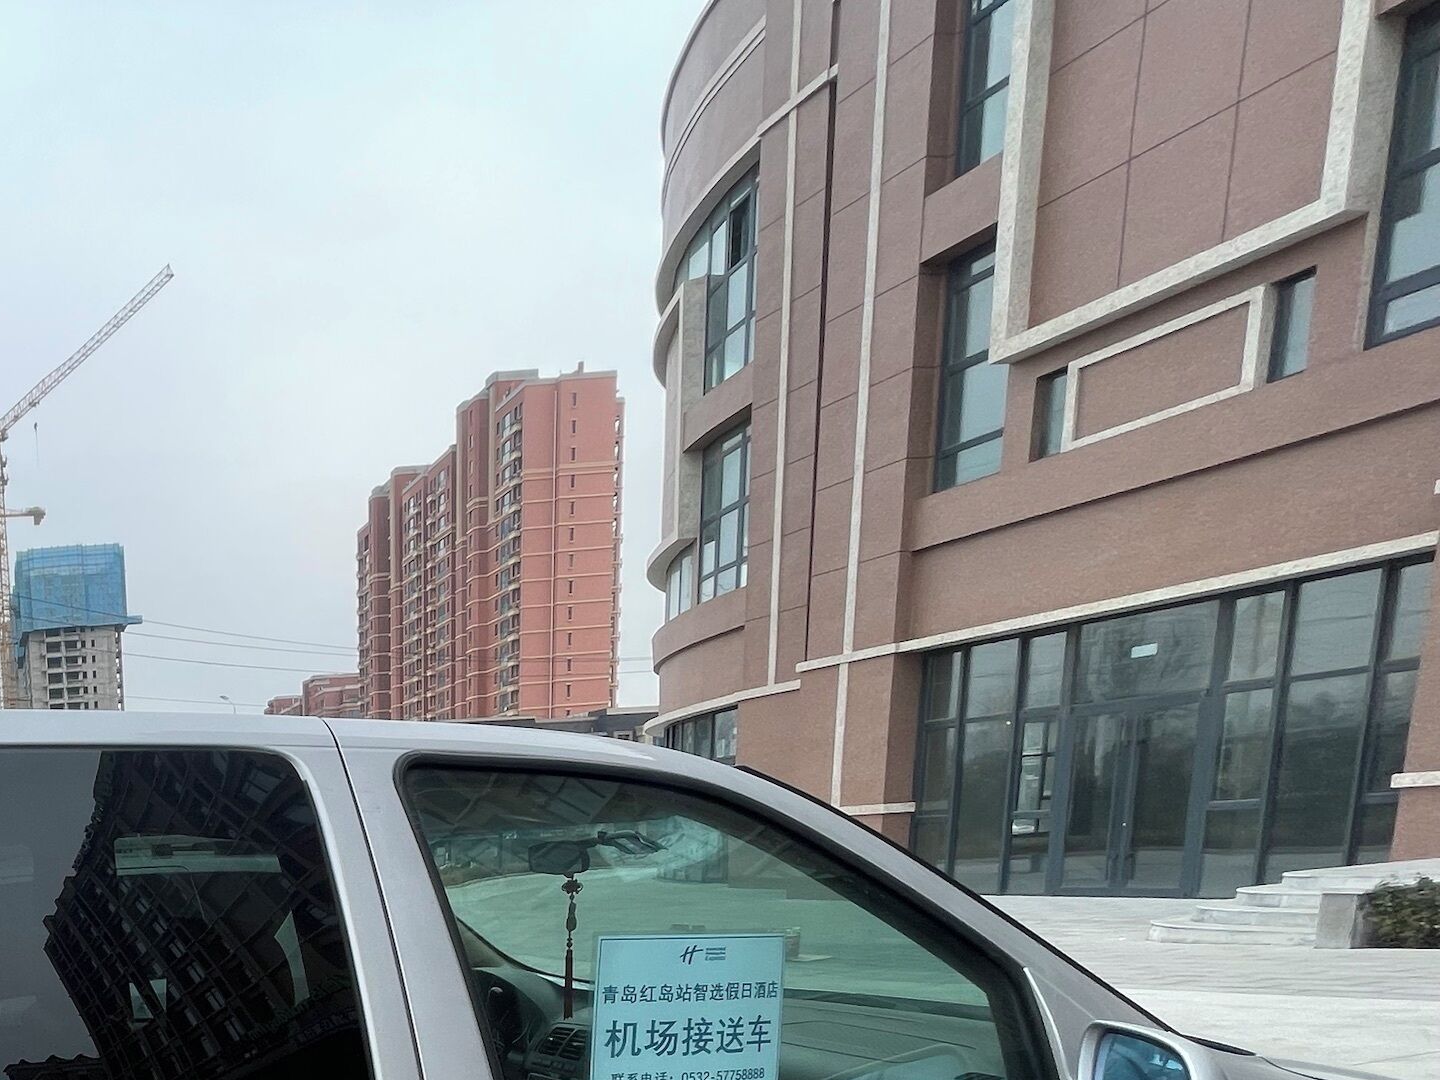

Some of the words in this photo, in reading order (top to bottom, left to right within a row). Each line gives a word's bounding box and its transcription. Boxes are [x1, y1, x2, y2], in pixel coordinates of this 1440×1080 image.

[602, 981, 778, 1004] 青岛红岛站智选假日酒店
[604, 1015, 771, 1058] 机场接送车
